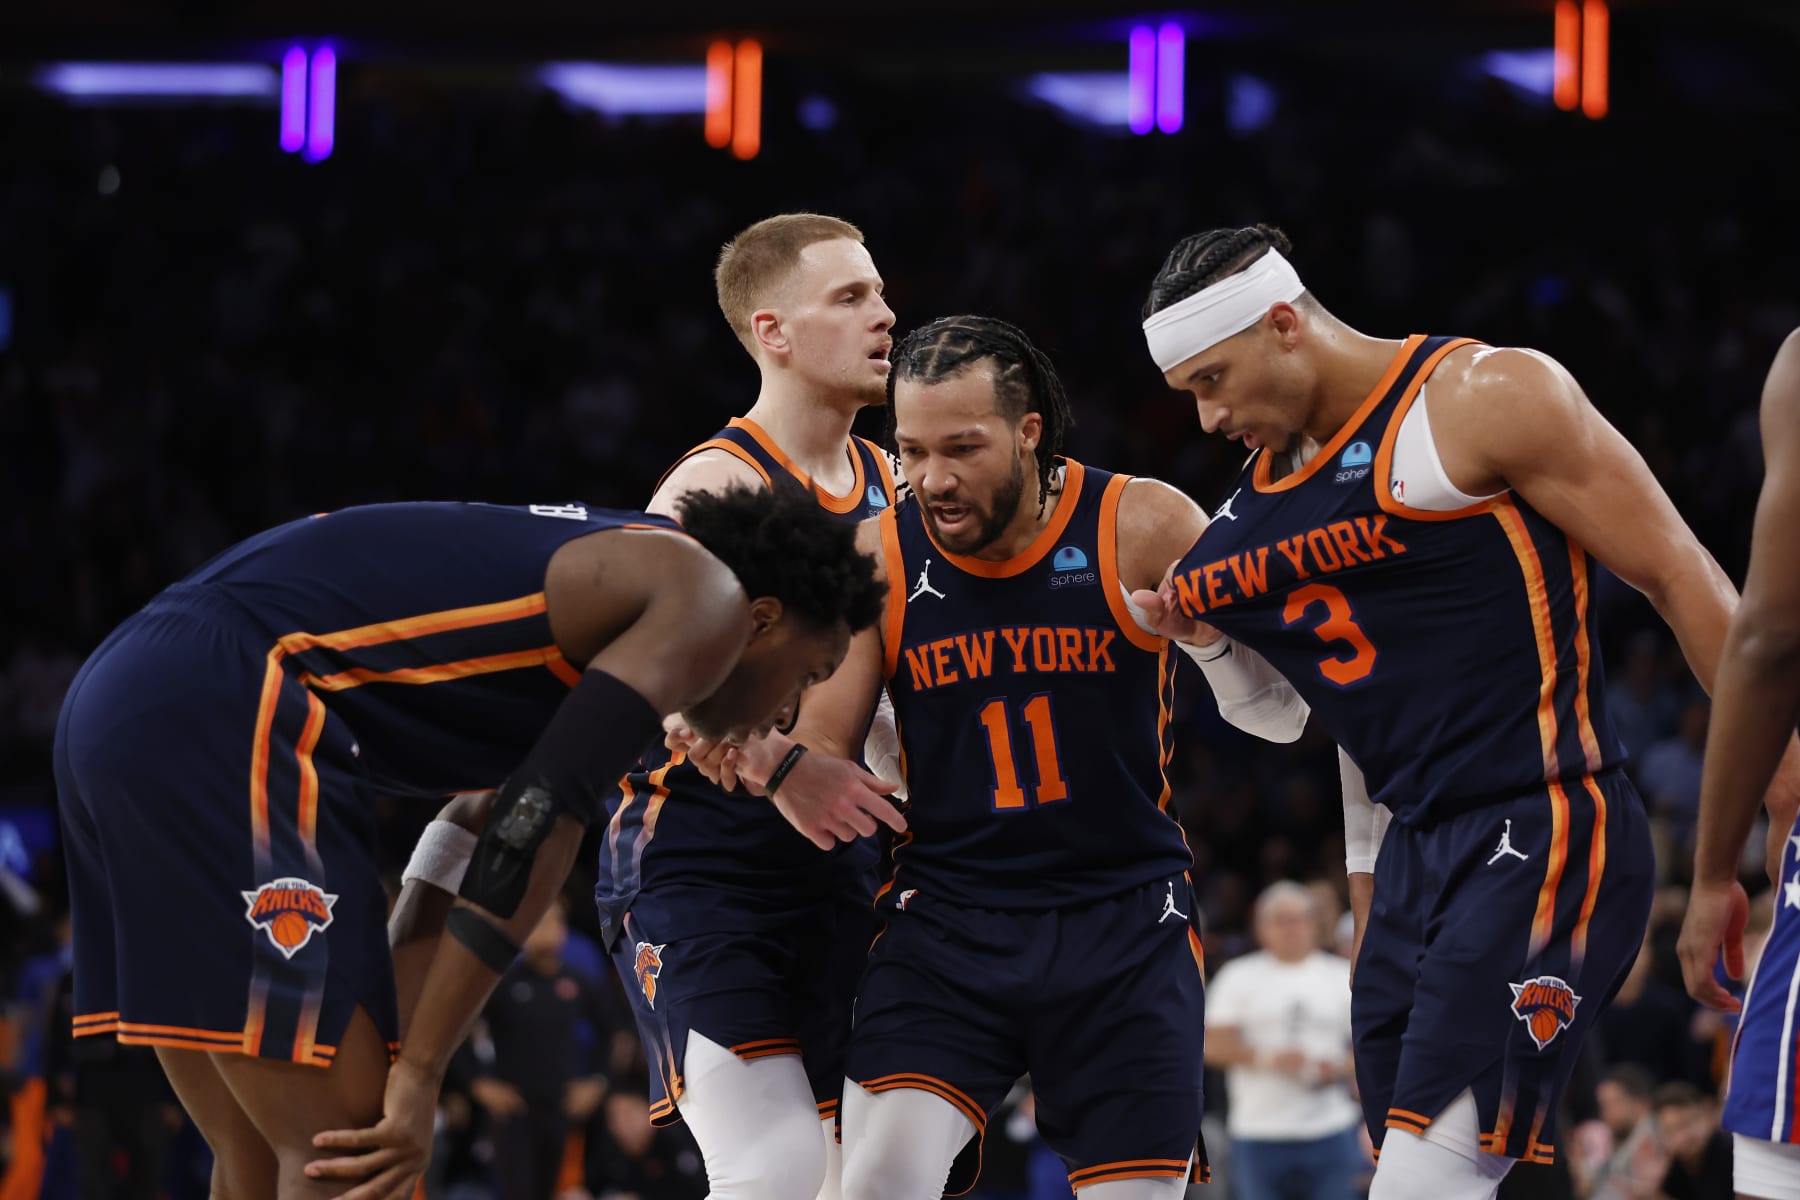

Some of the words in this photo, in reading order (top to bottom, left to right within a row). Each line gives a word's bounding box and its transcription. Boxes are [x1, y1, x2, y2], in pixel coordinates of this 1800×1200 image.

[1335, 468, 1370, 483] spher
[1050, 570, 1095, 588] sphere
[1174, 547, 1269, 618] NEW
[1276, 514, 1407, 580] YORK
[904, 630, 996, 692] NEW
[1001, 627, 1117, 673] YORK
[1281, 582, 1378, 687] 3
[978, 694, 1070, 811] 11
[250, 887, 330, 921] KNICKS
[1514, 983, 1574, 1019] KNICKS
